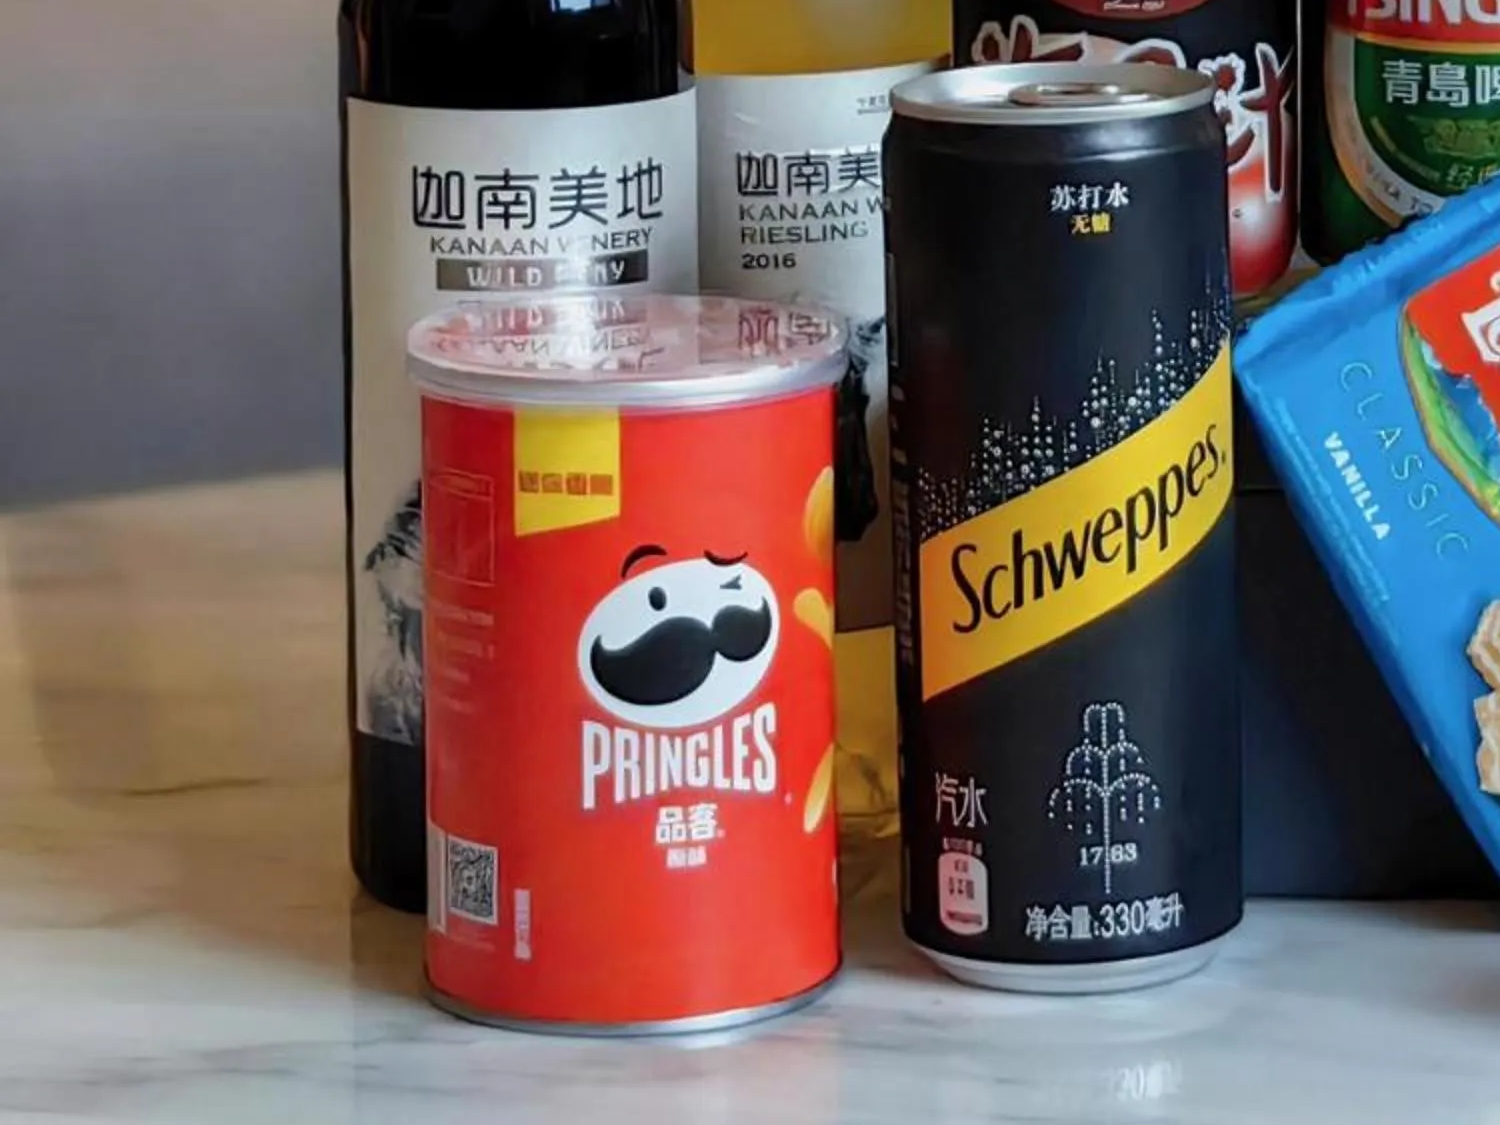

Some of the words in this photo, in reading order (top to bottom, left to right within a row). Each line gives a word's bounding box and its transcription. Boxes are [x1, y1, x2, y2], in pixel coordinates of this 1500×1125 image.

[737, 146, 881, 198] 迦南美
[739, 200, 859, 222] KANAAN
[1050, 181, 1130, 212] 苏打水
[430, 234, 550, 257] KANAAN
[741, 221, 869, 245] RIESLING
[465, 263, 543, 288] WILD
[742, 253, 797, 270] 2016
[1340, 361, 1469, 561] CLASSIC
[1324, 430, 1392, 541] VANILLA
[582, 701, 778, 810] PRINGLES
[935, 771, 989, 828] 汽水
[656, 802, 718, 844] 品客
[1080, 842, 1138, 867] 1783
